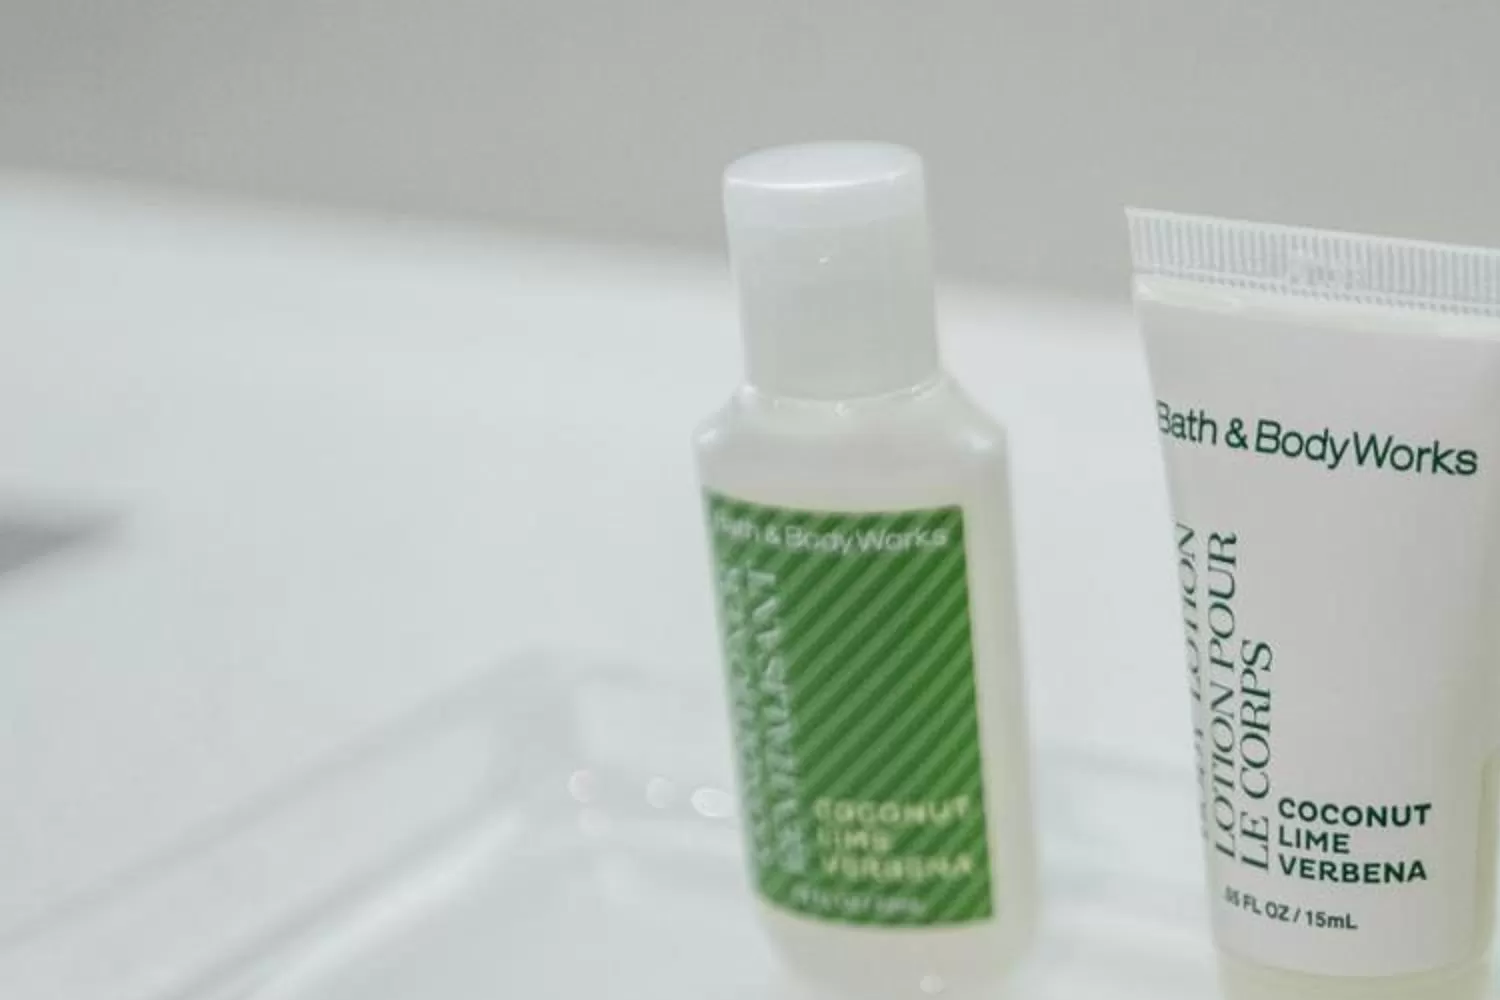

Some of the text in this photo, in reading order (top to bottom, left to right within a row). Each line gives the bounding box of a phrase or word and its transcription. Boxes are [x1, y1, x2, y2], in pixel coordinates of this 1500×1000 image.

[1157, 400, 1217, 445] Bath
[1225, 417, 1248, 450] &
[766, 524, 781, 545] &
[1206, 531, 1238, 860] LOTION POUR
[1239, 638, 1273, 871] LE CORPS
[813, 794, 970, 827] COCONUT
[1277, 796, 1432, 828] COCONUT
[1277, 824, 1351, 854] LIME
[1277, 852, 1428, 884] VERBENA
[1243, 893, 1262, 917] FL
[1265, 900, 1290, 922] OZ
[1305, 908, 1358, 930] 15mL
